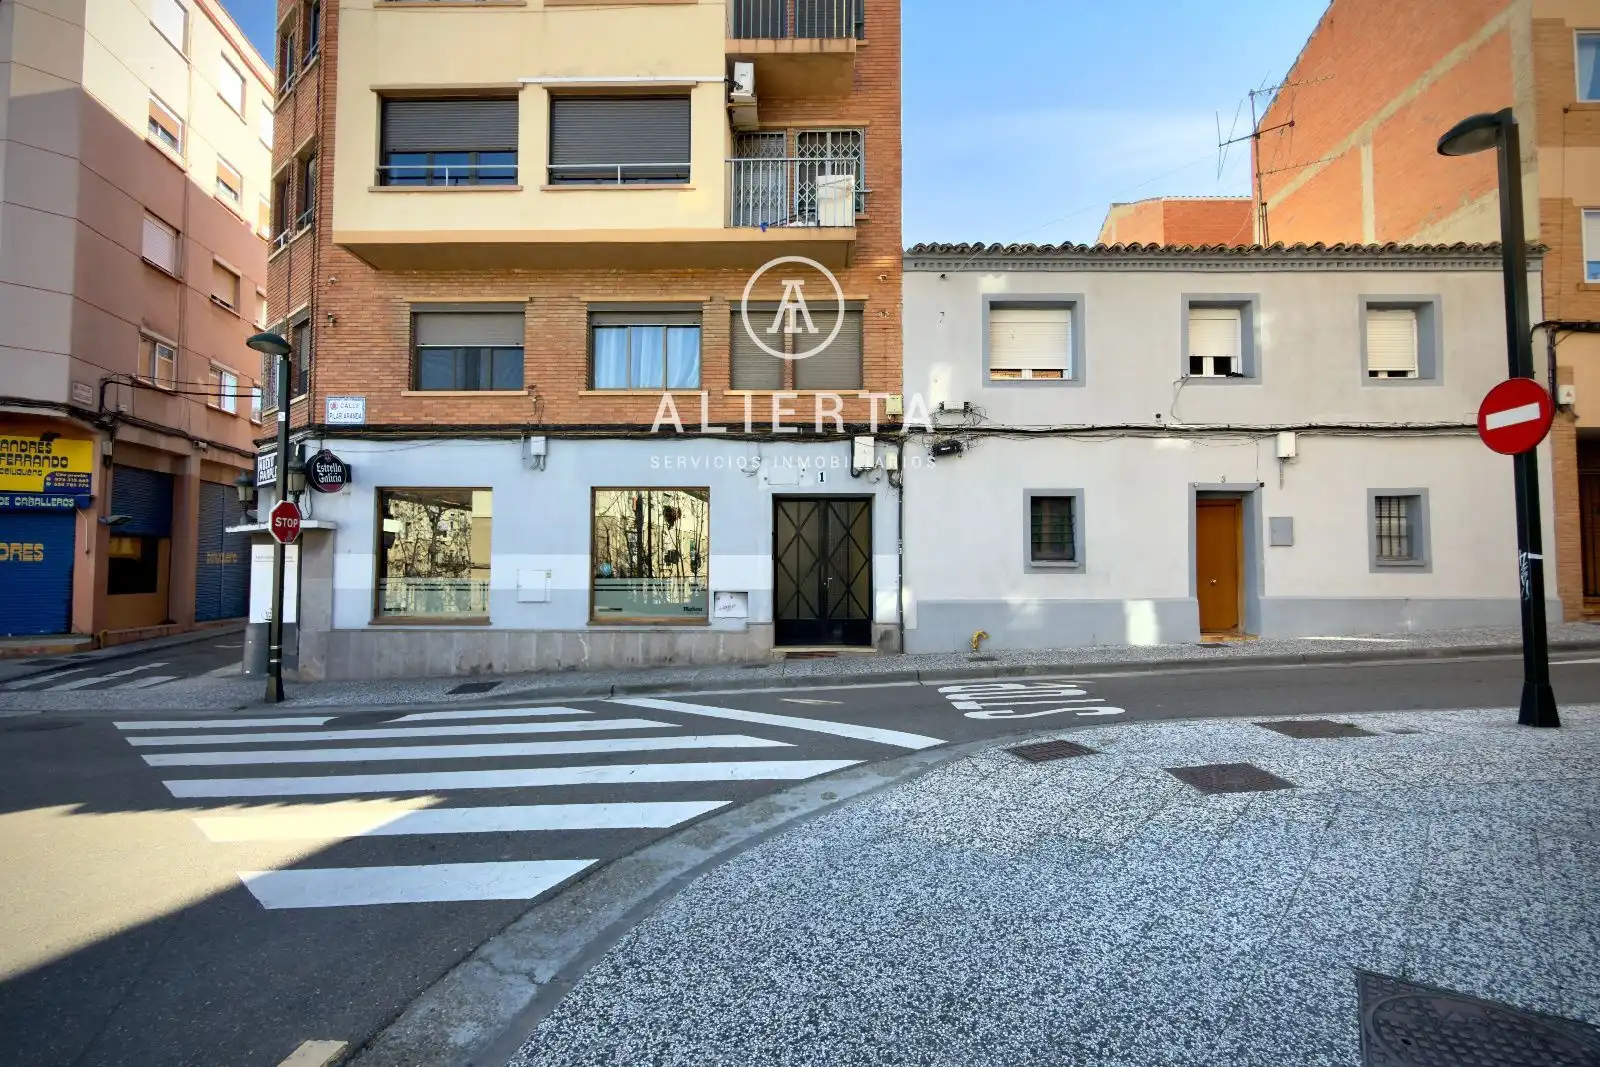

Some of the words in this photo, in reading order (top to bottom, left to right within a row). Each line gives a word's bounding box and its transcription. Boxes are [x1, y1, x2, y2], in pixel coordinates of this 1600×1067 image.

[0, 439, 53, 454] ANDRES
[0, 453, 69, 468] FERRANDO
[316, 462, 342, 473] Estrella
[319, 472, 342, 483] Galicia
[819, 471, 825, 482] 1
[14, 496, 75, 507] CABALLEROS
[275, 516, 298, 528] STOP
